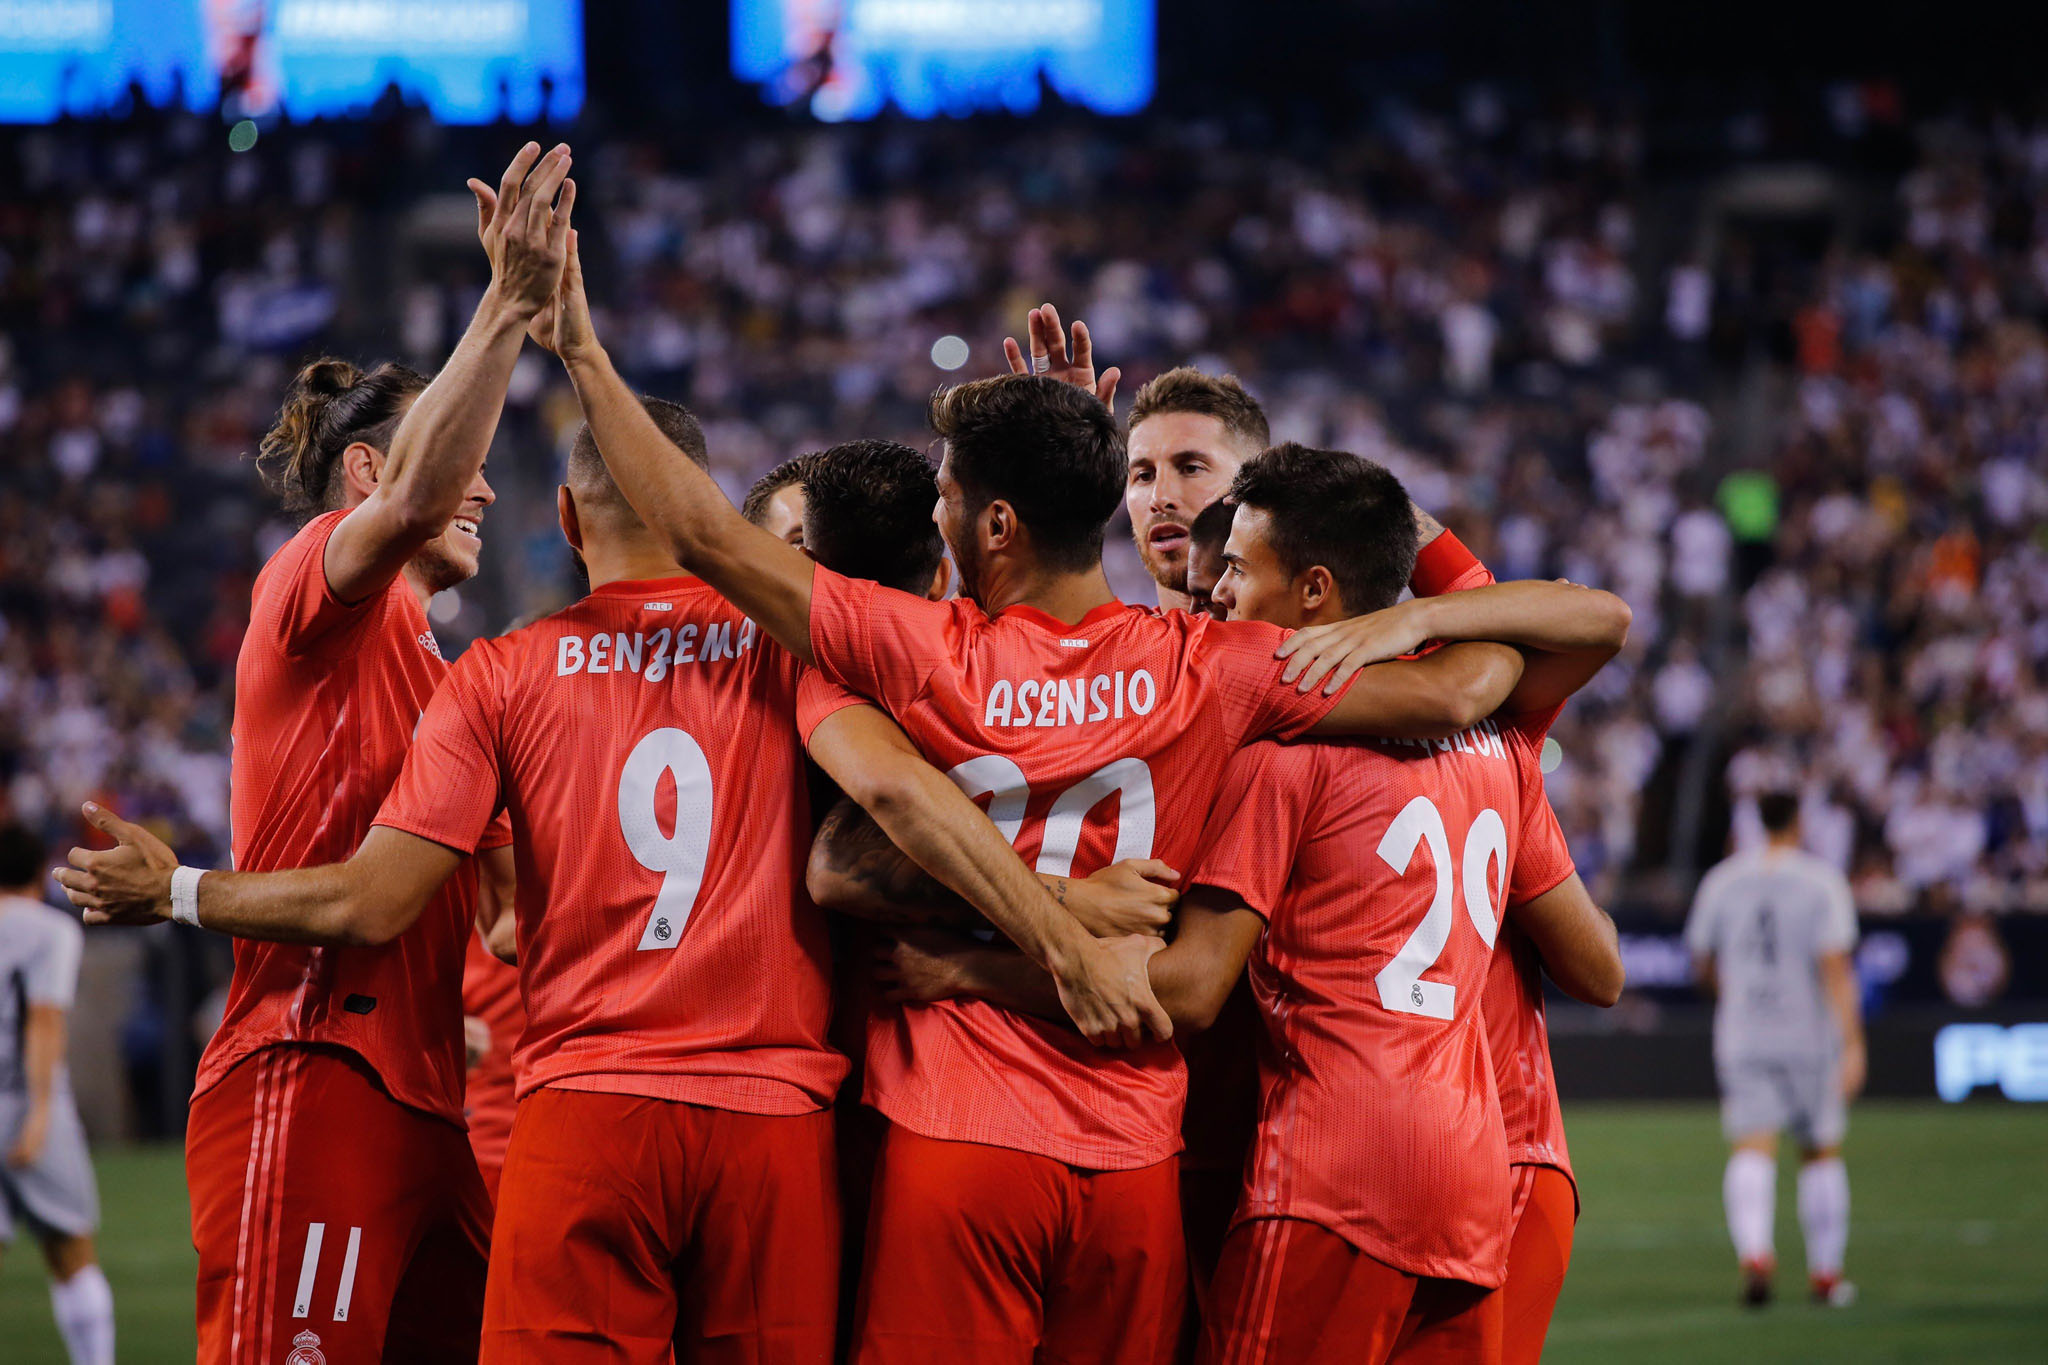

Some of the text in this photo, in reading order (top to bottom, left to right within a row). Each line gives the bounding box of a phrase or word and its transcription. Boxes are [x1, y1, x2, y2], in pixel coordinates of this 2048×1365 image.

[417, 632, 445, 664] adida
[557, 616, 757, 683] BENZEMA
[984, 669, 1156, 727] ASENSIO
[617, 727, 714, 951] 9
[1374, 795, 1508, 1021] 20
[292, 1222, 362, 1322] 11
